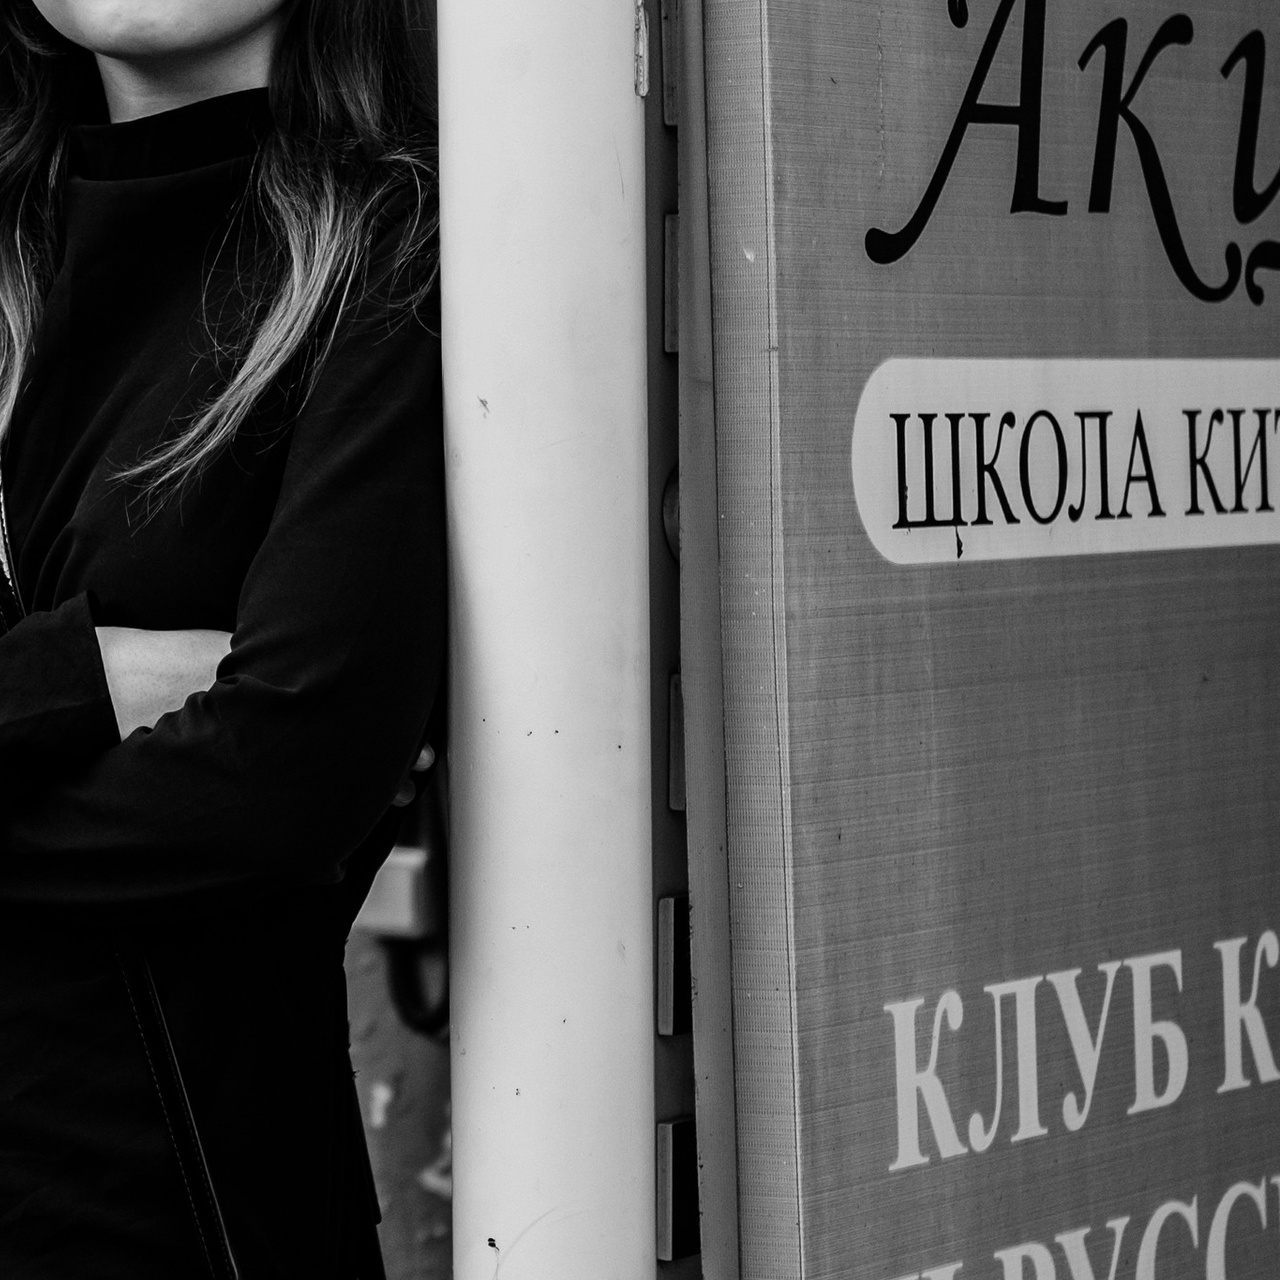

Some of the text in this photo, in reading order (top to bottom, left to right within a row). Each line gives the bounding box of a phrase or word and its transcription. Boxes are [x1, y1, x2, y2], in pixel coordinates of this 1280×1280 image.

[889, 407, 1280, 530] ШКОЛА КИ
[883, 949, 1189, 1172] КЛУБ
